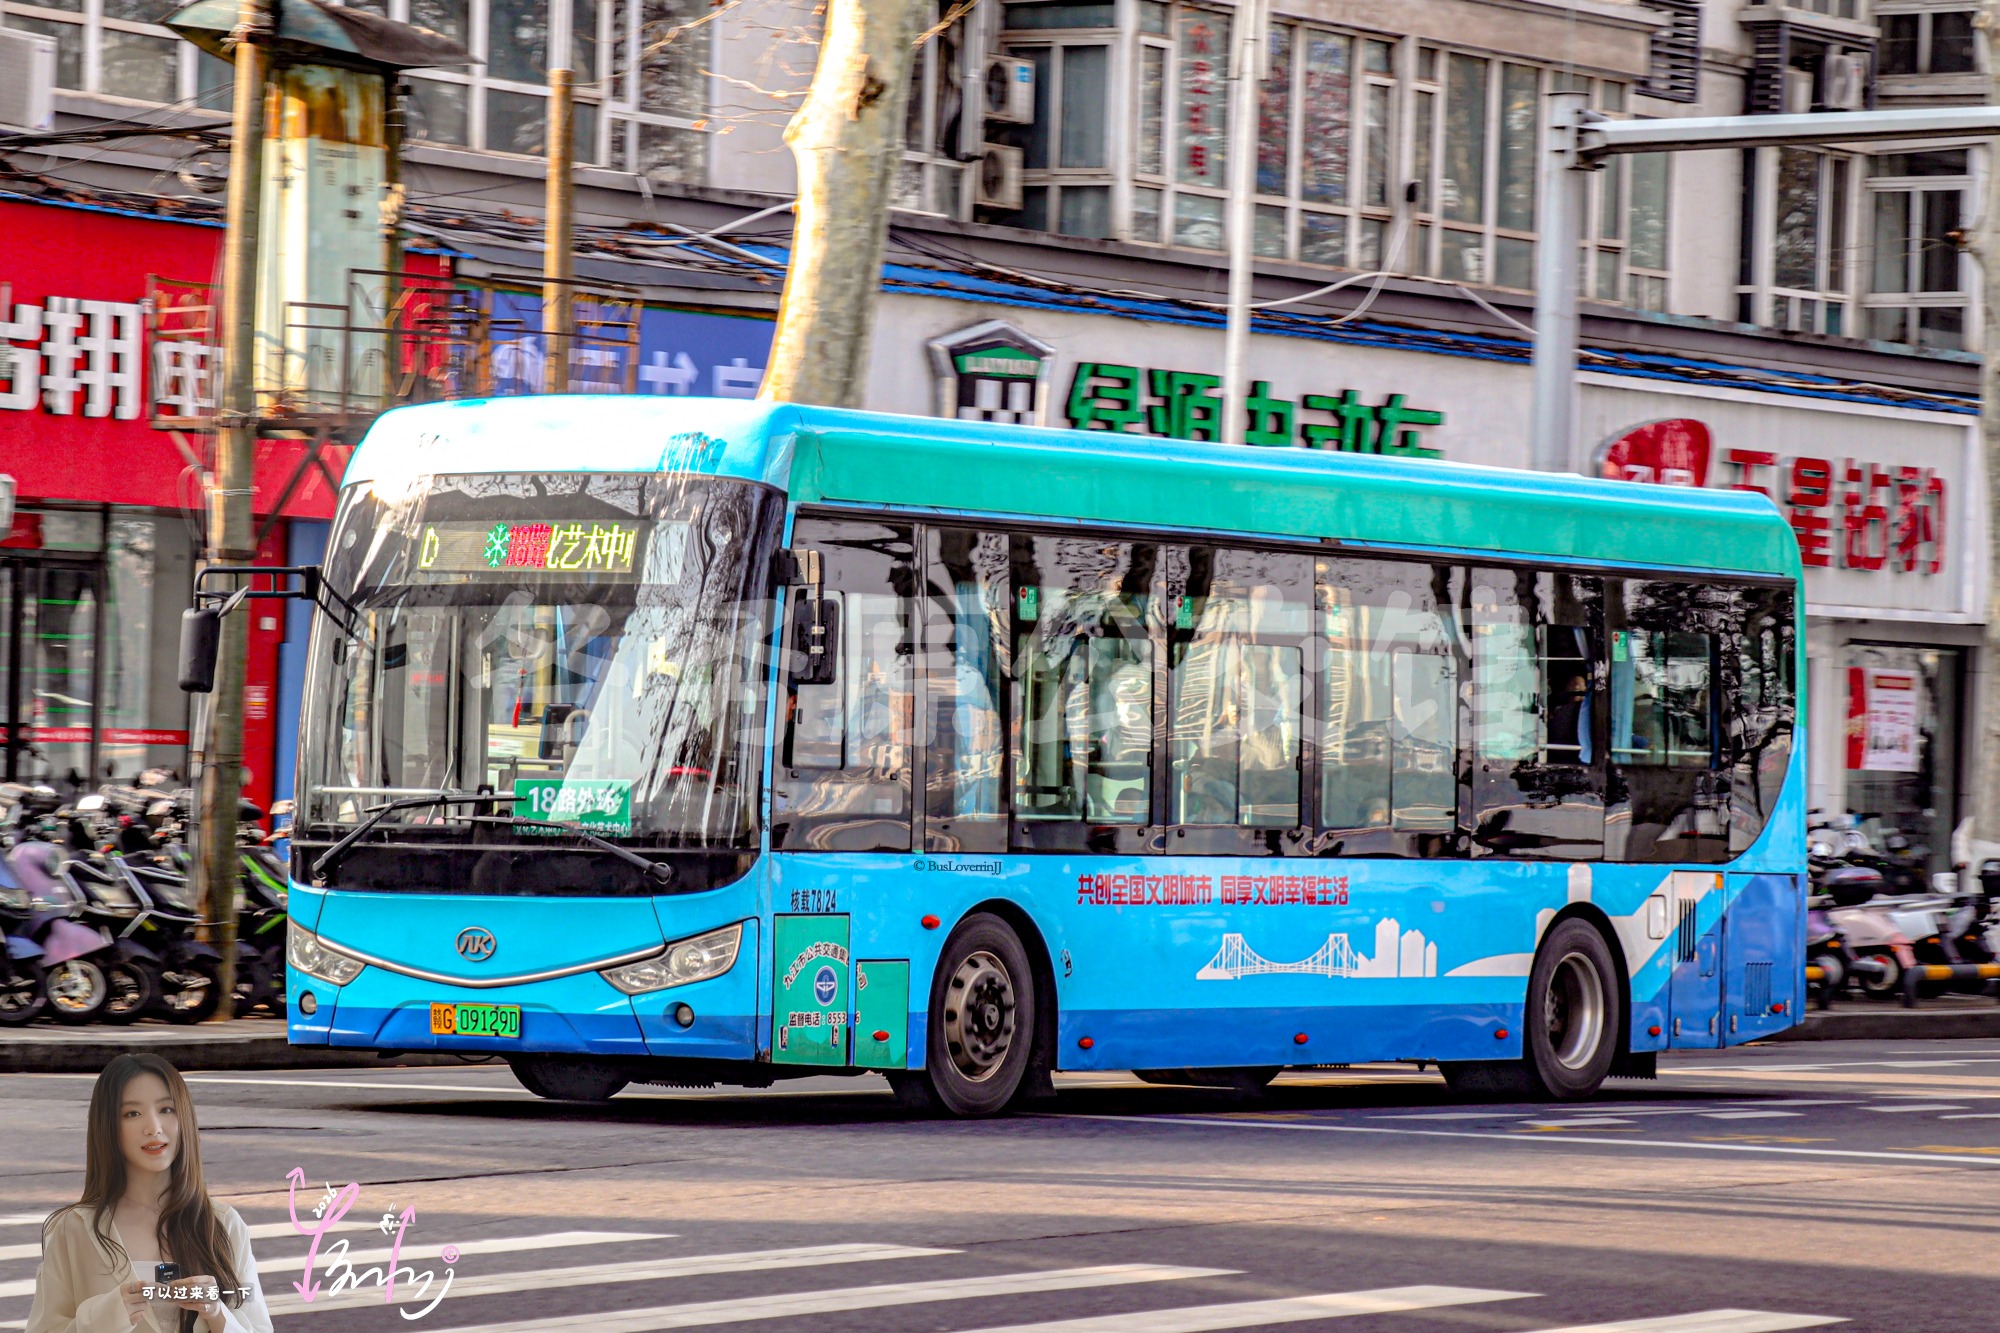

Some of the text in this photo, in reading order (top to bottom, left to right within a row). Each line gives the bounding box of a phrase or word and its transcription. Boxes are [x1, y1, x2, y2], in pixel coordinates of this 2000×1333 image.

[528, 786, 616, 814] 18路外环
[1077, 873, 1349, 906] 共创全国文明城市 同享文明幸福生活
